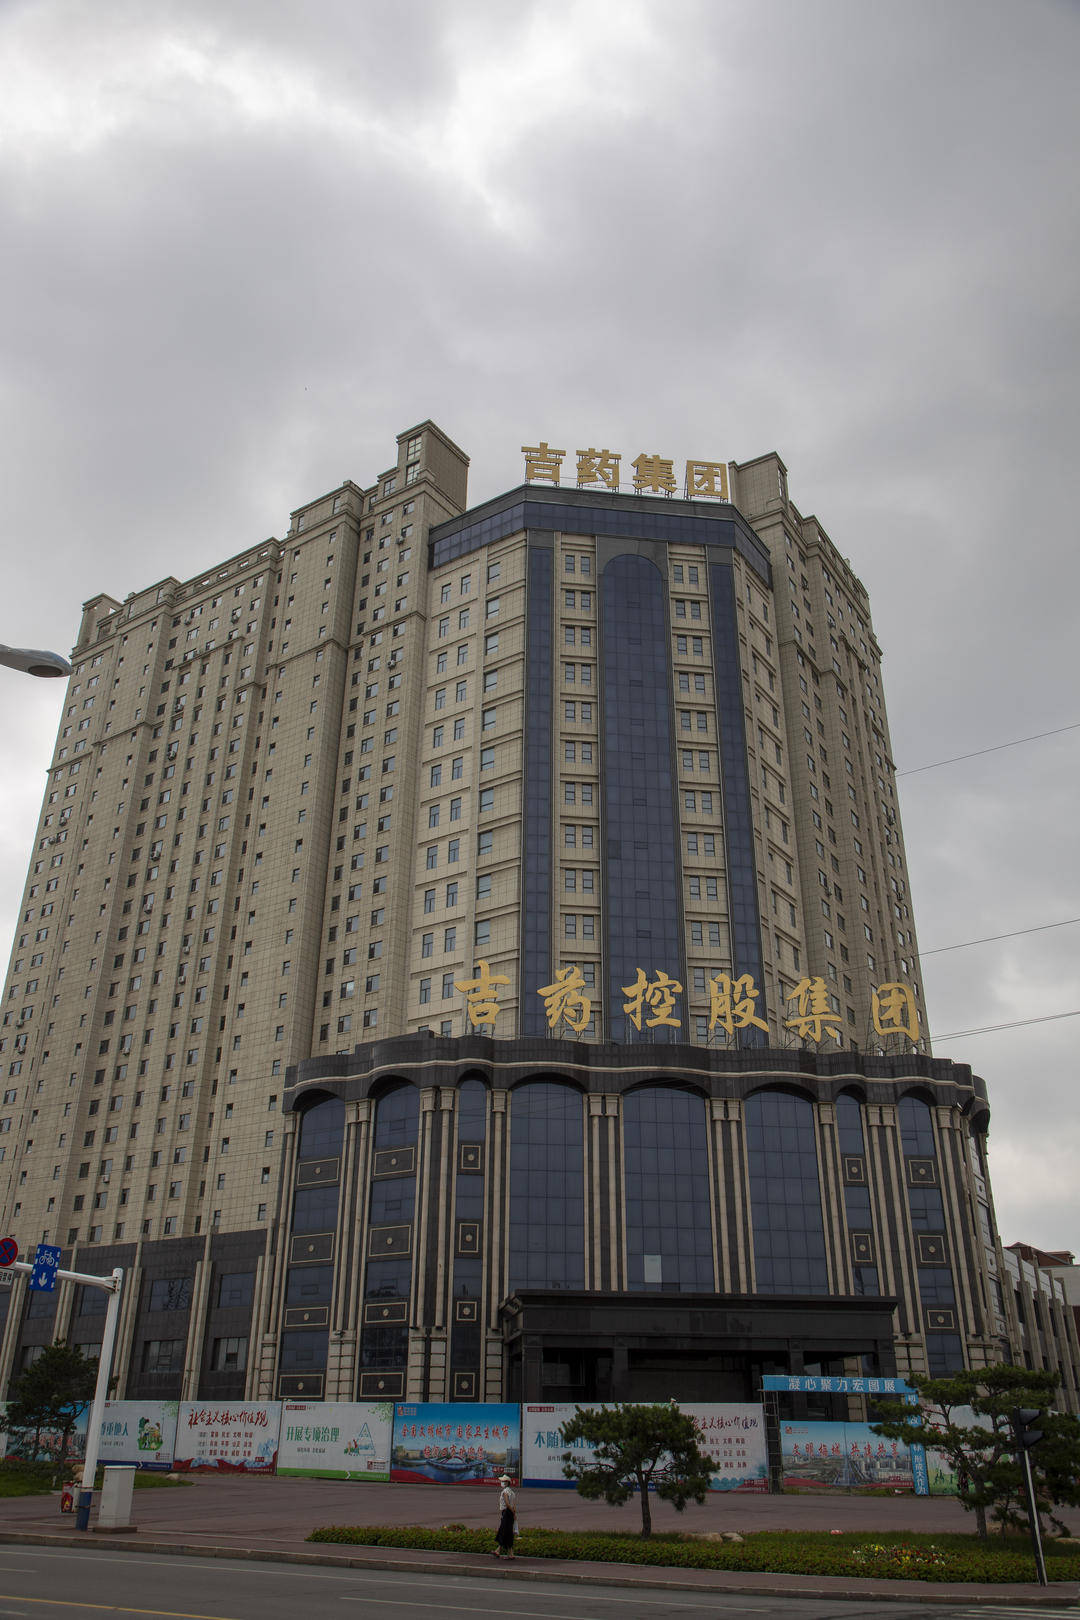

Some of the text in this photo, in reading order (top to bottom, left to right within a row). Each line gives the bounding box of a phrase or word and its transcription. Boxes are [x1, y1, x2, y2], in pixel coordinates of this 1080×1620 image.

[521, 442, 729, 500] 吉药集团
[454, 960, 919, 1043] 吉药控股集团
[788, 1378, 896, 1392] 凝心聚力宏图展
[188, 1408, 268, 1429] 社会主义核心价值观
[691, 1415, 760, 1430] 会主义核心价值观
[286, 1426, 340, 1442] 开展专项治理
